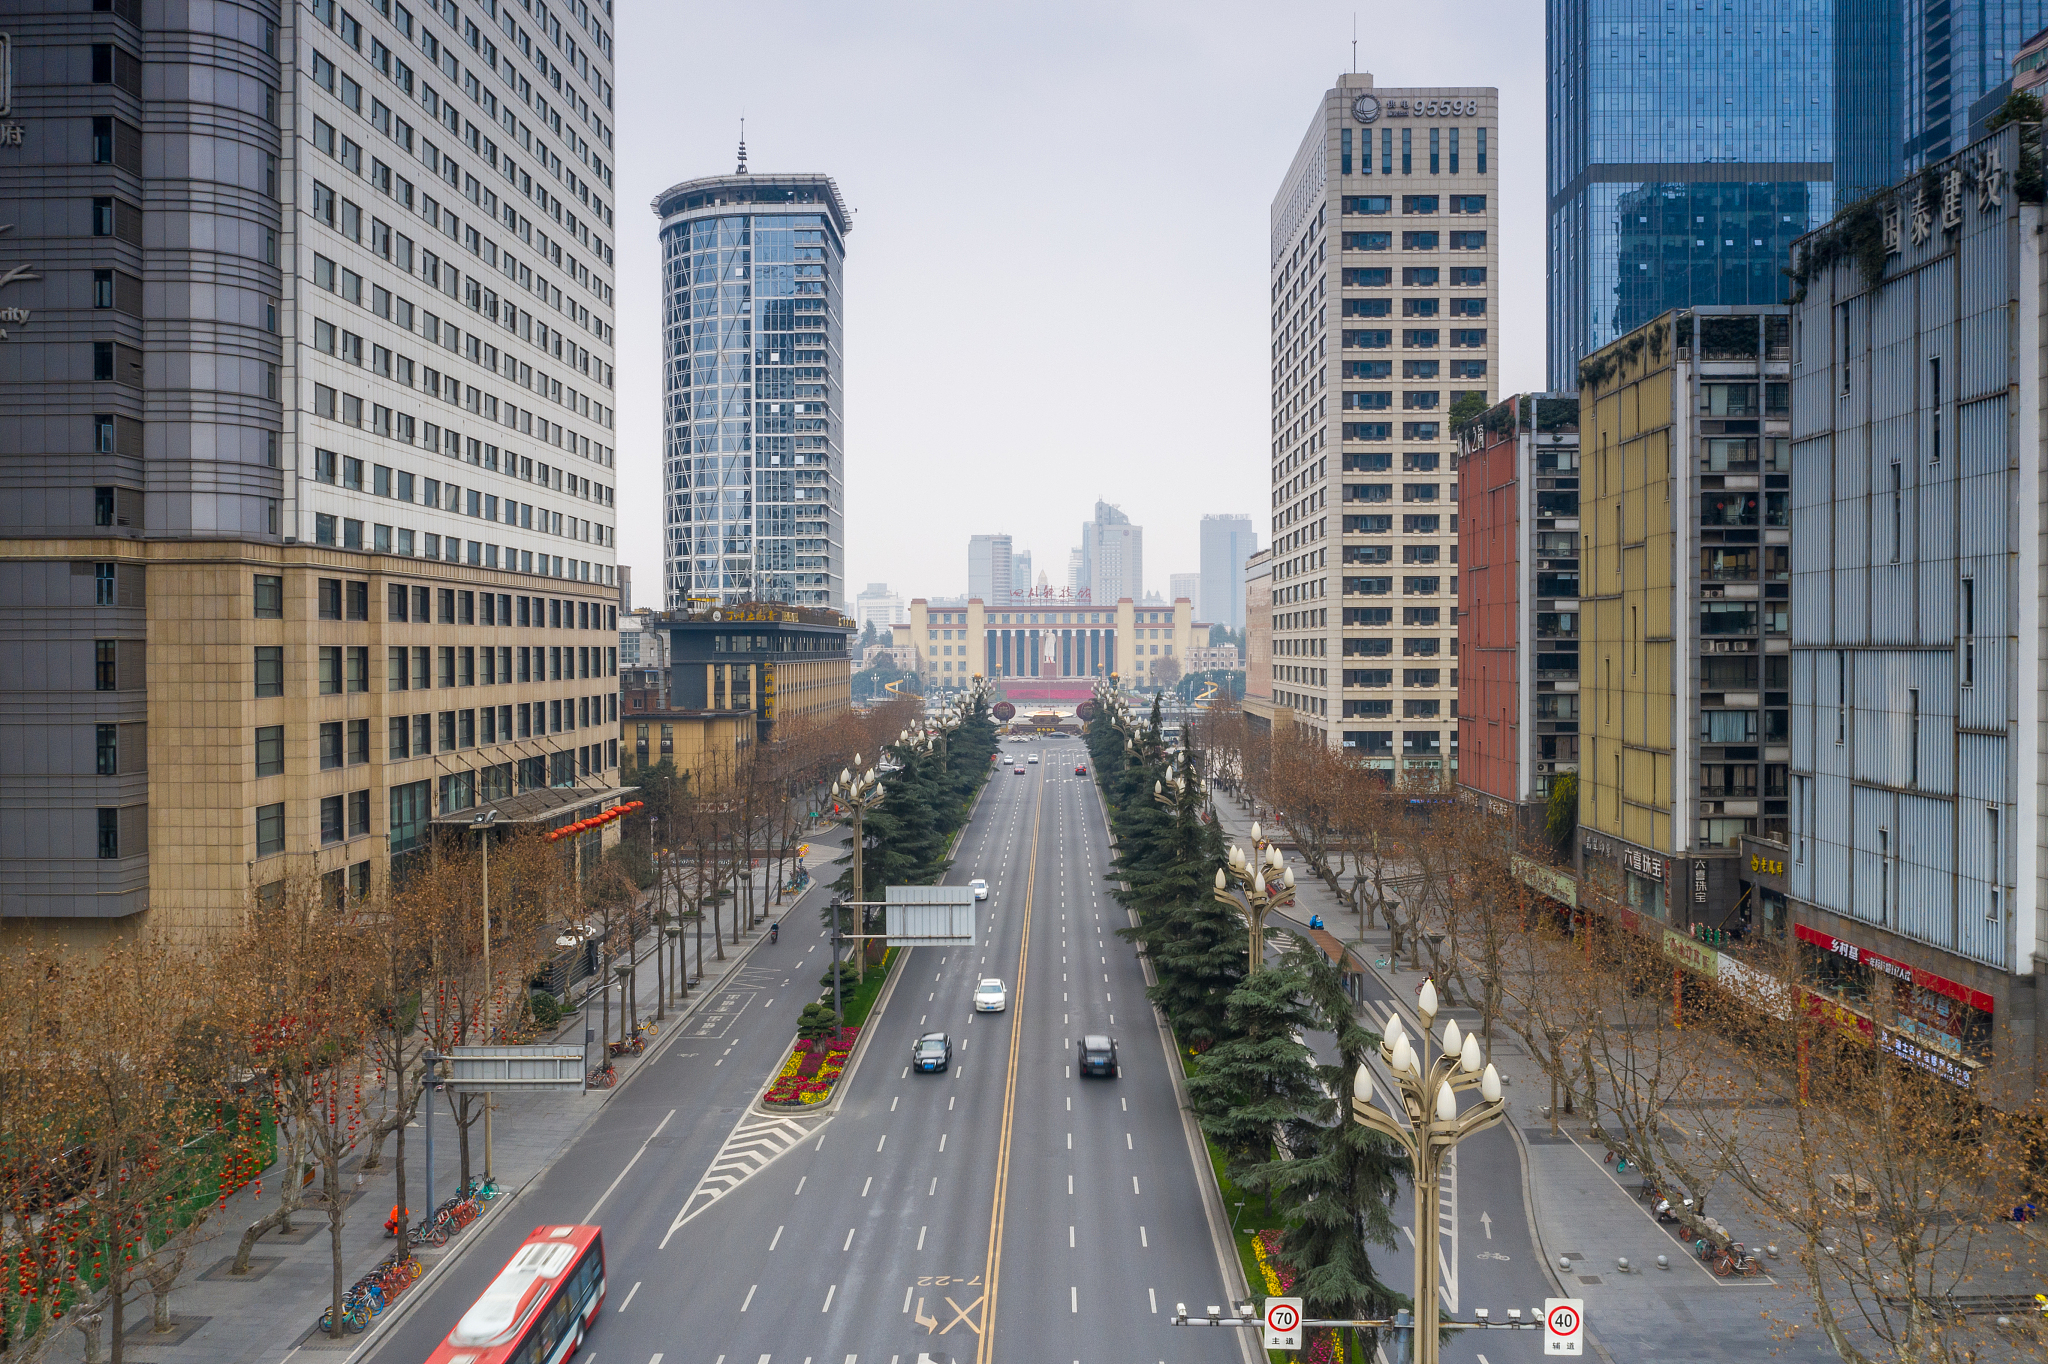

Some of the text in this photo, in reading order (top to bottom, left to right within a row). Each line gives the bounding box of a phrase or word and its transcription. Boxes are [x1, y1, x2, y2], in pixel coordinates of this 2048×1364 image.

[1413, 99, 1478, 118] 95598
[0, 306, 31, 326] rity
[1624, 847, 1662, 878] 六喜珠宝
[1695, 859, 1707, 903] 六喜珠宝
[1831, 939, 1859, 961] 乡村基
[917, 1275, 982, 1286] 7-22
[1276, 1312, 1292, 1325] 70
[1555, 1313, 1572, 1328] 40
[1272, 1337, 1294, 1345] 主道
[1552, 1342, 1575, 1350] 辅道
